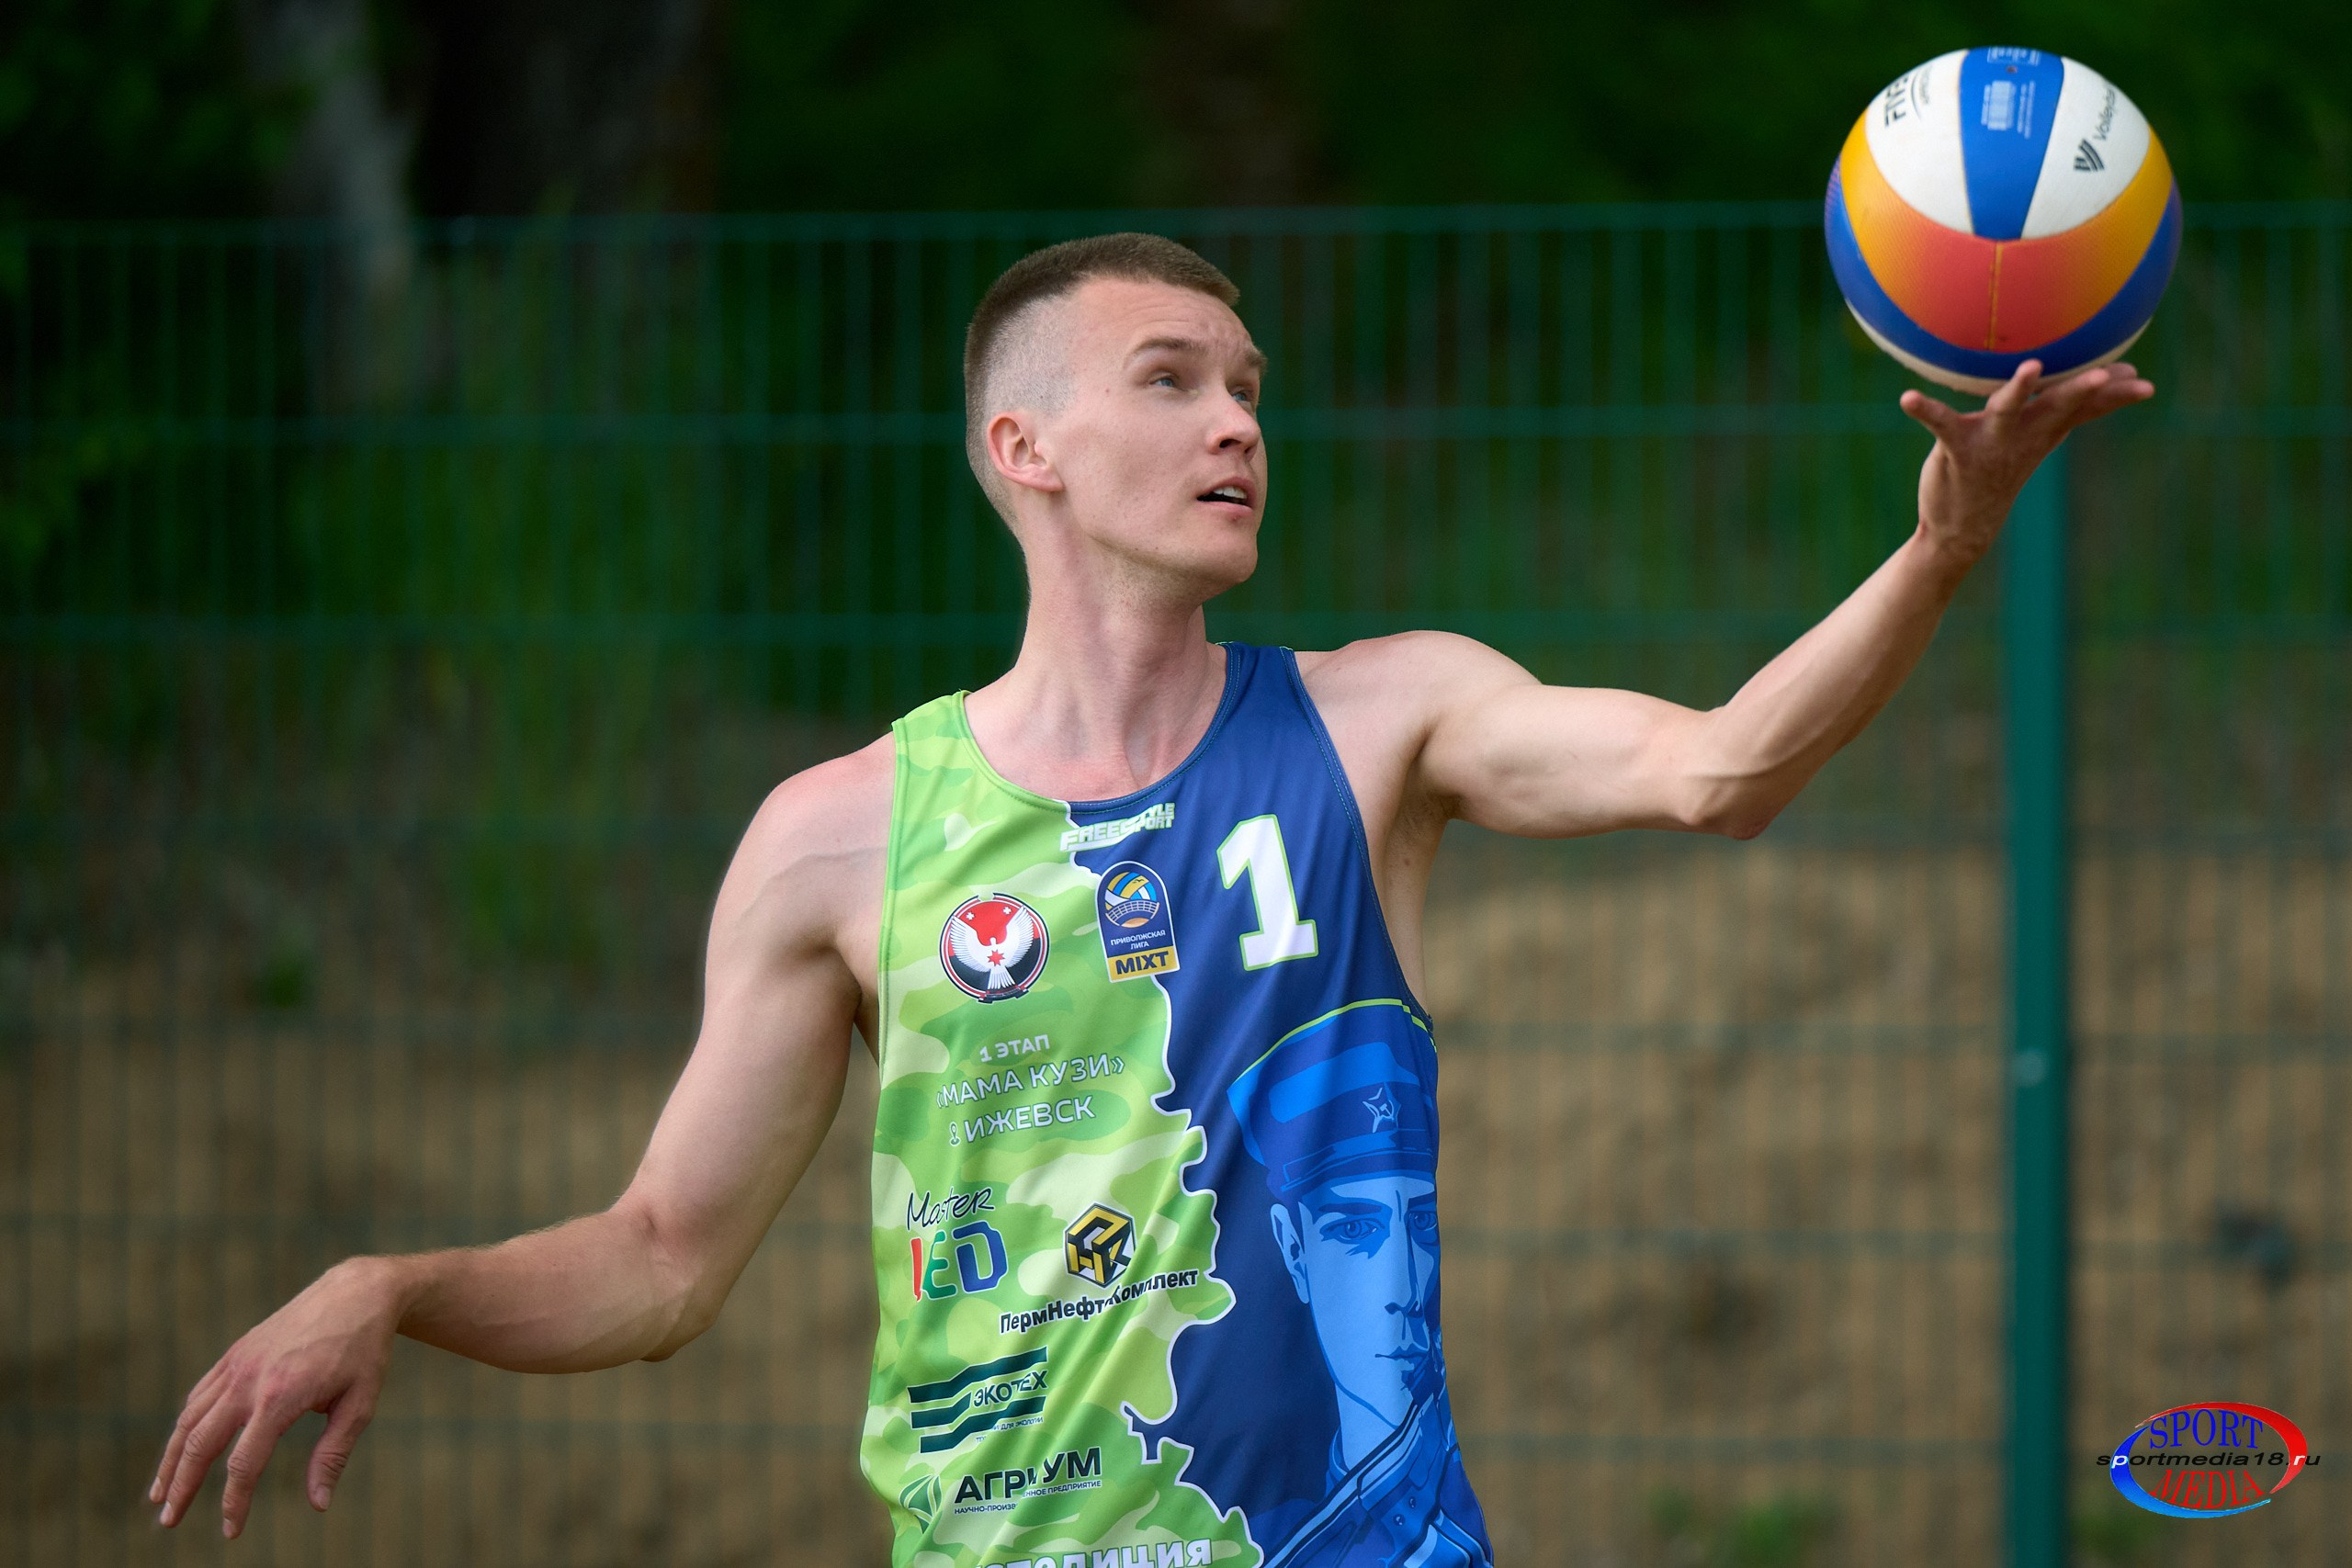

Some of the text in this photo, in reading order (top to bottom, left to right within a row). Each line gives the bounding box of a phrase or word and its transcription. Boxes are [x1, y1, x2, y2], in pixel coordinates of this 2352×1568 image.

[1216, 814, 1319, 972] 1
[1110, 930, 1166, 946] ПРИВОЛЖСКАЯ
[1130, 941, 1150, 950] ЛИГА
[1115, 951, 1170, 975] MIXT
[979, 1034, 1051, 1063] 1 ЭТАП
[1029, 1054, 1126, 1089] КУЗИ»
[964, 1095, 1097, 1144] ИЖЕВСК
[1000, 1269, 1199, 1334] ПермНефтКомплект
[1047, 1480, 1102, 1495] ПРЕДПРИЯТИЕ
